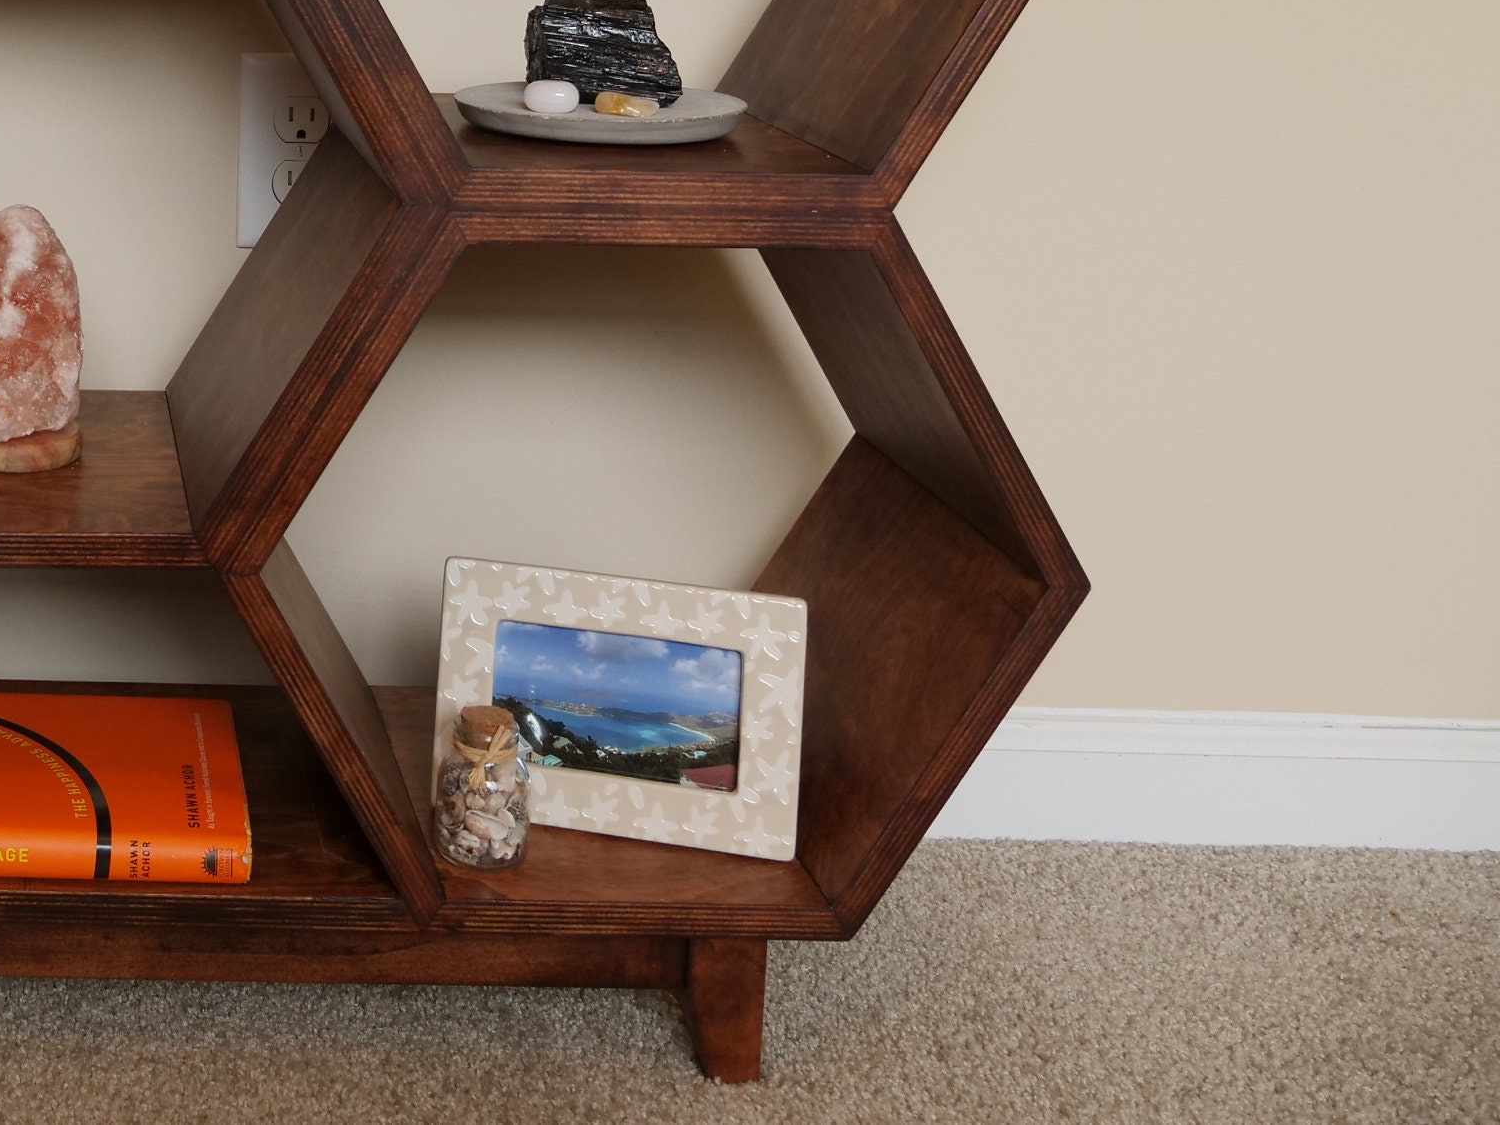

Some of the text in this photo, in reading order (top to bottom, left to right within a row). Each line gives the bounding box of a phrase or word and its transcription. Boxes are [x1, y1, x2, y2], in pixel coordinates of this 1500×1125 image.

[30, 748, 82, 795] HAPPINESS
[71, 798, 88, 818] THE
[182, 764, 201, 828] SHAWN ACHOR
[129, 840, 139, 878] SHAWN
[141, 841, 151, 878] ACHOR
